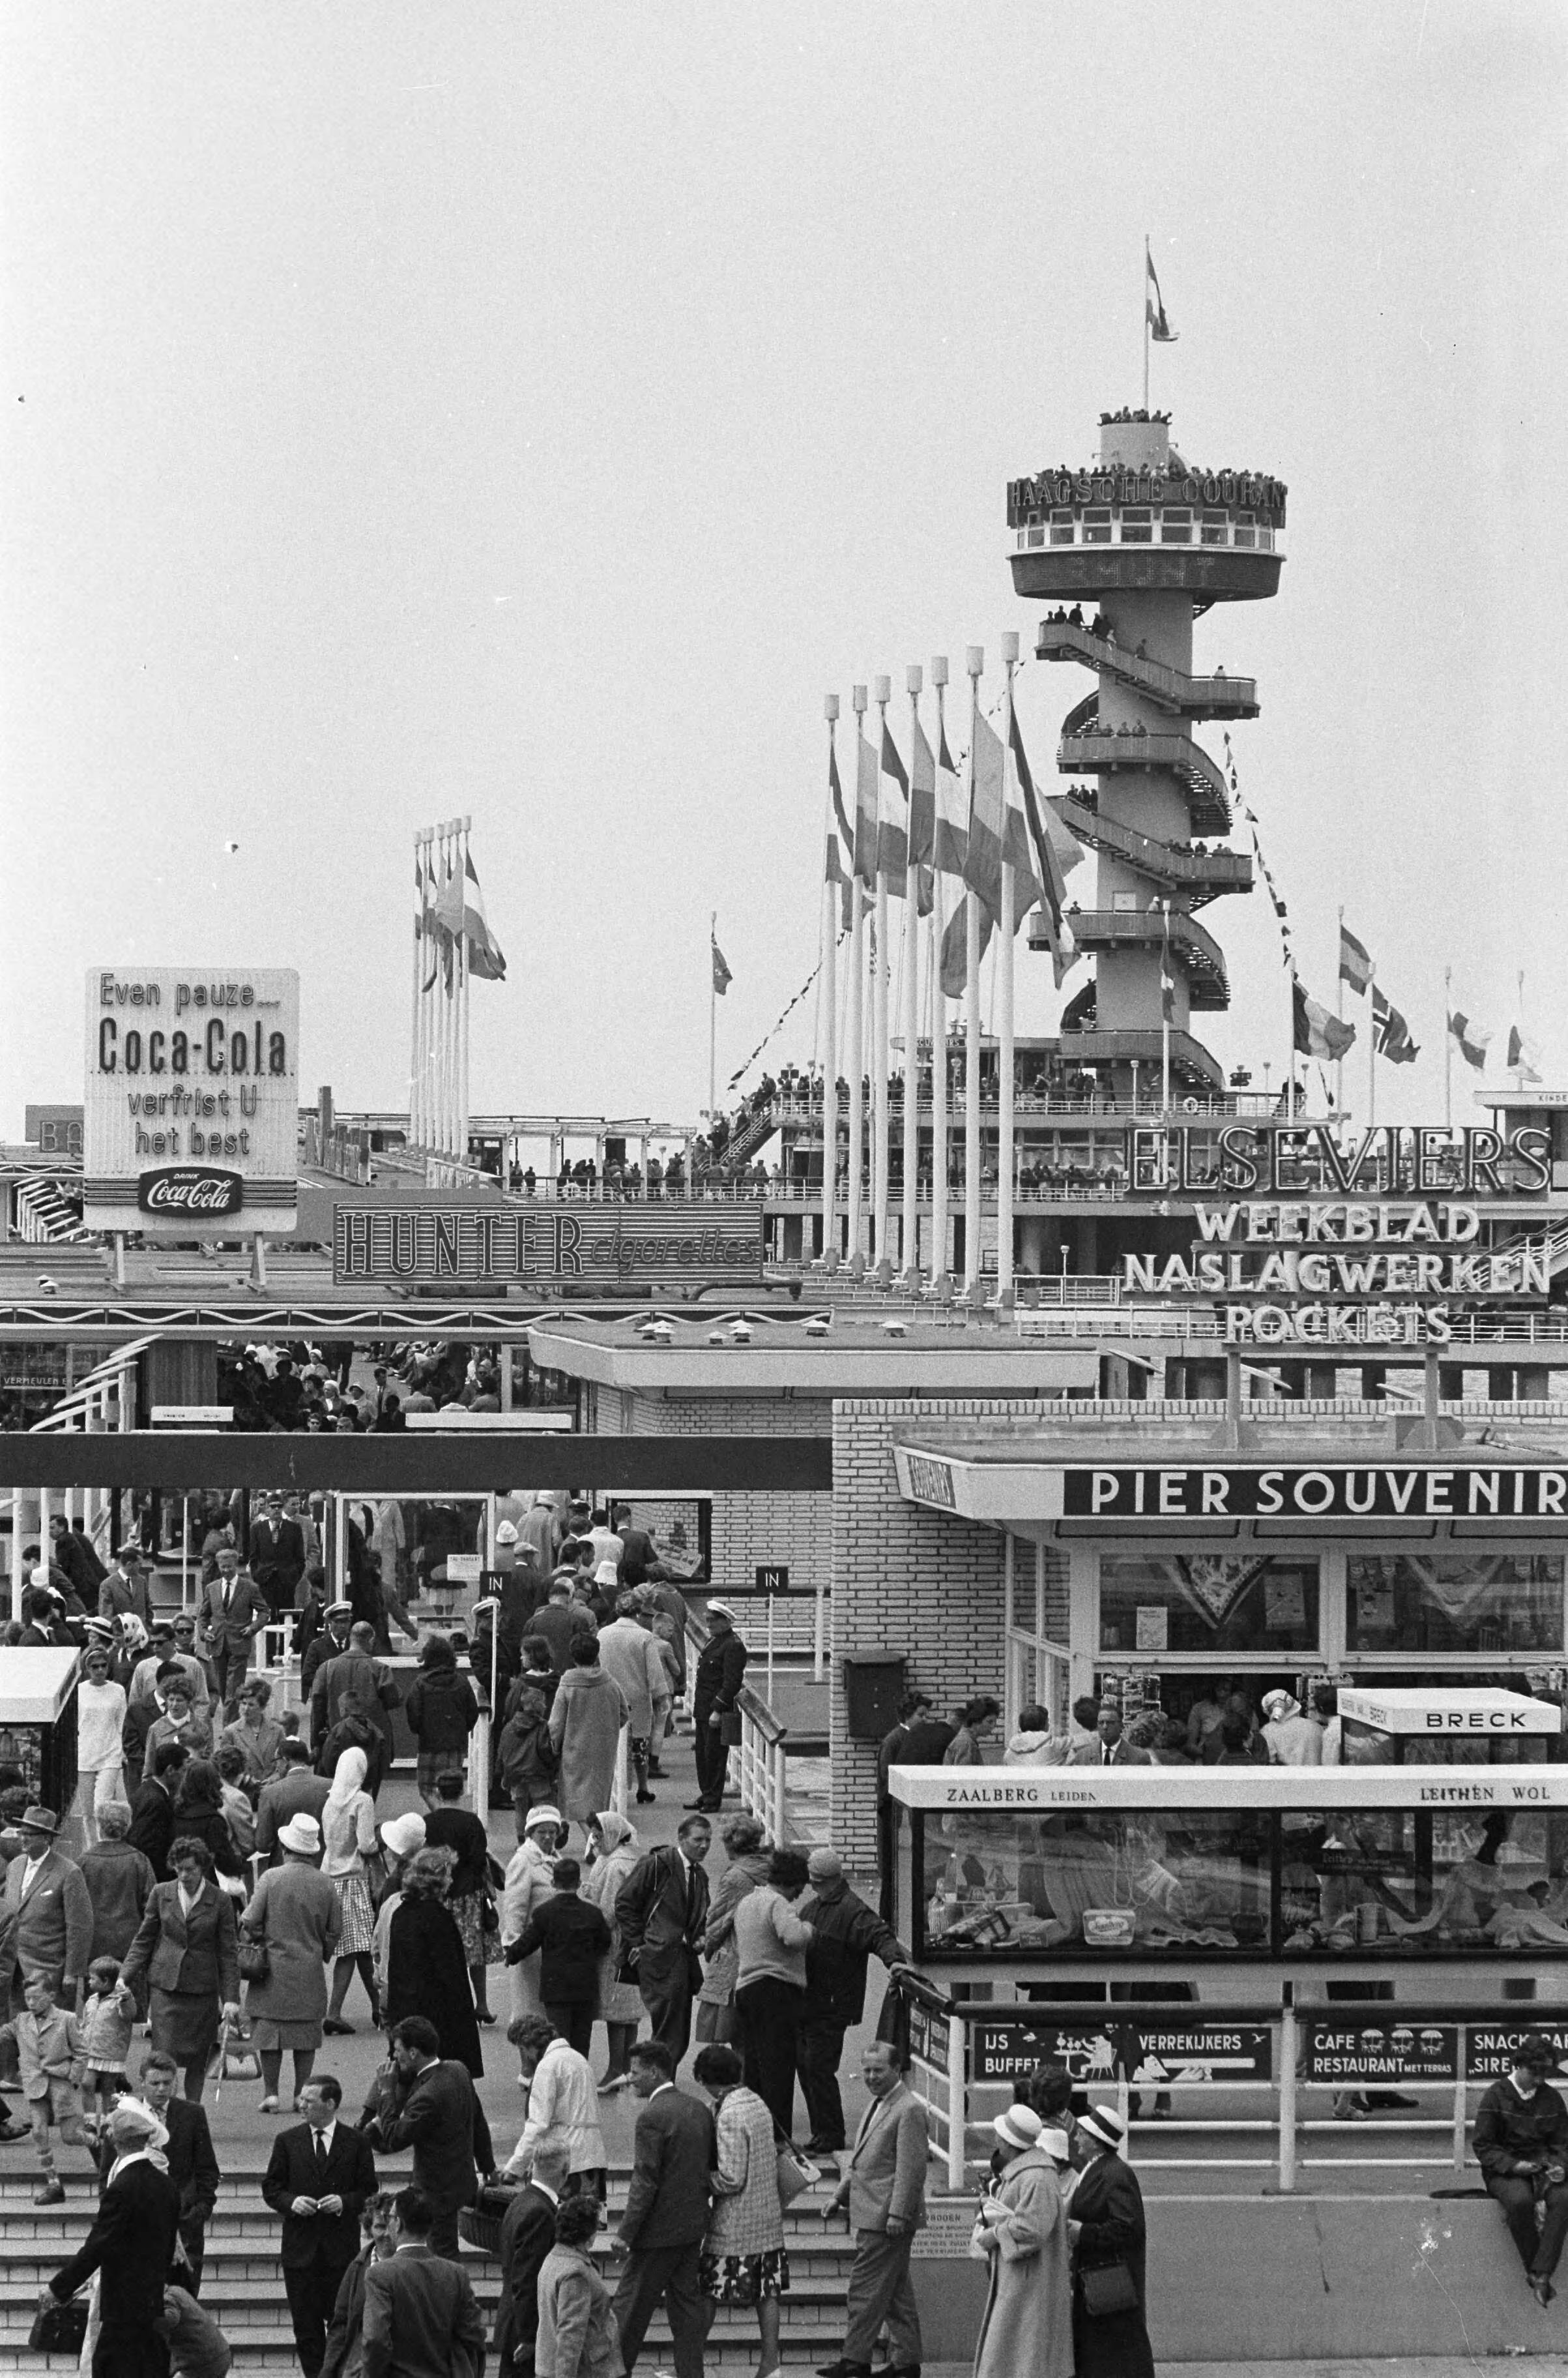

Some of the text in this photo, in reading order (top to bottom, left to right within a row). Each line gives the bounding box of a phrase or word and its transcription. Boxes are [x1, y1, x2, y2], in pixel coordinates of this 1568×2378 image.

[1012, 477, 1164, 506] HAAGSCHE
[100, 973, 160, 1005] Even
[99, 1017, 285, 1072] Coca-Cola
[127, 1084, 257, 1116] verfrist U
[135, 1122, 250, 1154] het best
[1125, 1126, 1552, 1194] ELSEVIERS
[147, 1179, 235, 1208] Coca-Cola
[1192, 1203, 1479, 1242] WEEKBLAD
[341, 1213, 756, 1276] HUNTER cigarettes
[1123, 1253, 1550, 1293] NASLAGWERKEN
[1225, 1304, 1451, 1344] POCKETS
[1092, 1471, 1566, 1514] PIER SOUVENIR
[489, 1576, 502, 1591] IN
[765, 1572, 779, 1587] IN
[1426, 1712, 1527, 1727] BRECK
[947, 1788, 1097, 1802] ZAALBERG LEIDEN
[1512, 1786, 1550, 1800] WOL
[985, 2033, 1009, 2050] IJS
[1139, 2034, 1241, 2051] VERREKIJKERS
[1314, 2034, 1355, 2050] CAFE
[1474, 2033, 1530, 2050] SNACK
[1313, 2057, 1452, 2073] RESTAURANT MET TERRAS
